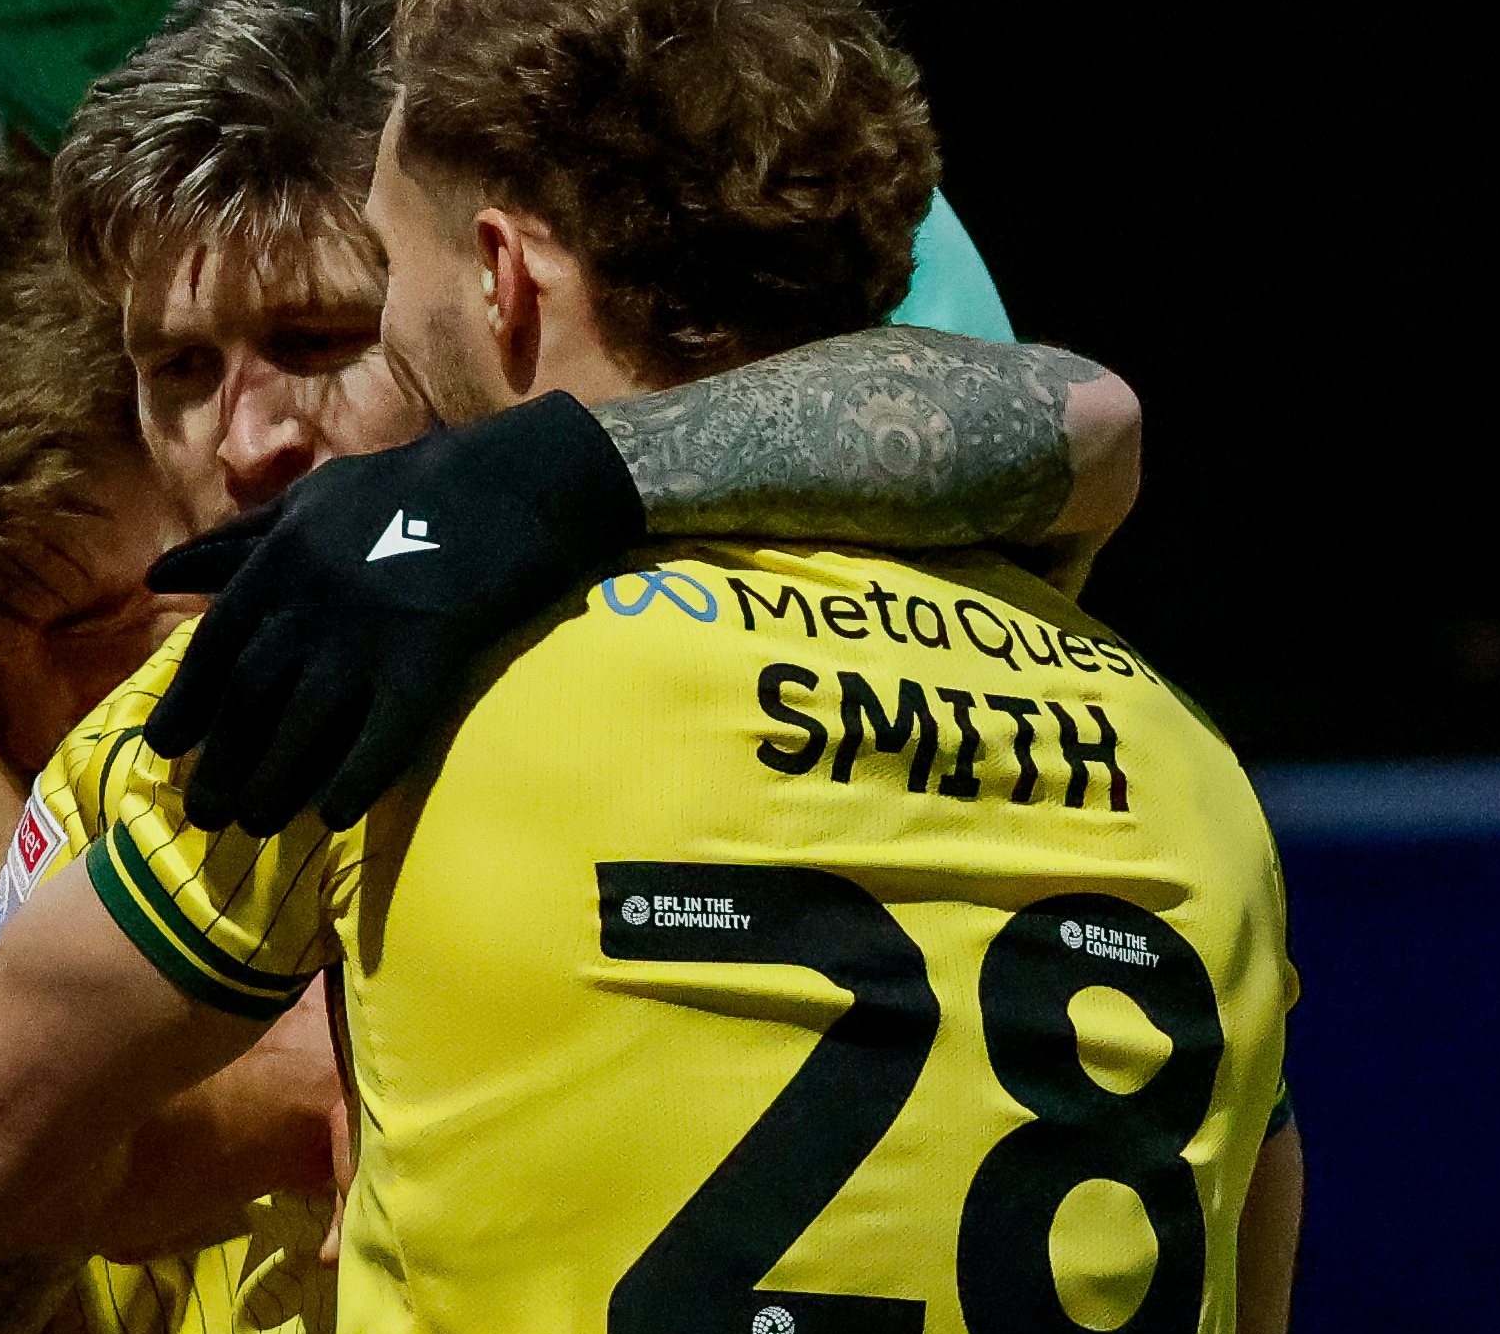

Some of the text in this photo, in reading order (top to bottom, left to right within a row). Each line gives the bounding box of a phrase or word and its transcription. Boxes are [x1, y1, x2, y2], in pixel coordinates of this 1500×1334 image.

[756, 662, 1130, 813] SMITH
[653, 895, 735, 913] EFL IN THE
[654, 912, 751, 930] COMMUNITY
[1085, 924, 1148, 951] EFL IN THE
[1086, 940, 1160, 968] COMMUNITY
